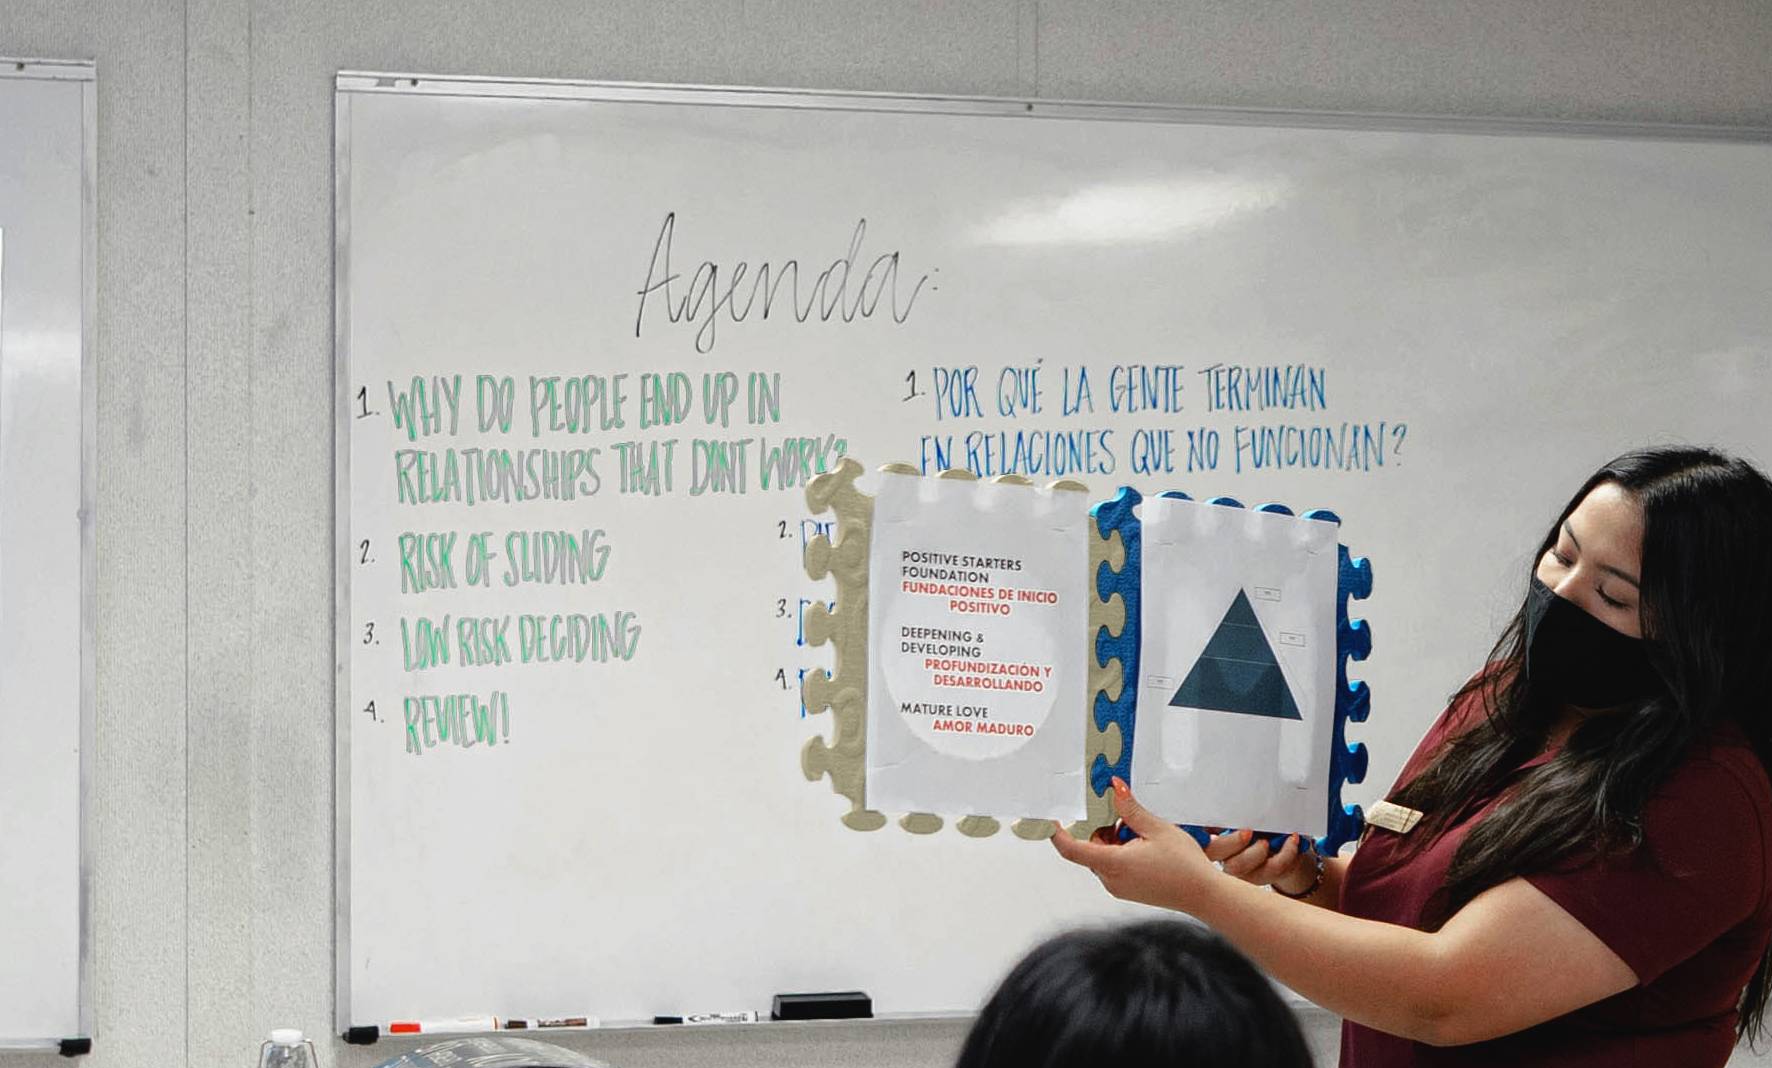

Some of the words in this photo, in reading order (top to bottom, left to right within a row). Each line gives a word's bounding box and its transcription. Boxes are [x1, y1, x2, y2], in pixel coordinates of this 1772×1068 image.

[636, 211, 940, 354] Agenda:
[902, 369, 926, 402] 1.
[933, 364, 984, 421] POR
[997, 358, 1043, 418] QUÉ
[1063, 365, 1094, 417] LA
[1110, 364, 1185, 413] GENTE
[1197, 362, 1327, 413] TERMINAN
[357, 385, 380, 420] 1.
[387, 374, 461, 442] WHY
[476, 374, 514, 434] DO
[529, 374, 628, 438] PEOPLE
[640, 371, 692, 430] END
[703, 371, 739, 428] UP
[748, 372, 780, 424] IN
[921, 433, 953, 477] EN
[965, 429, 1116, 480] RELACIONES
[1130, 428, 1175, 476] QUE
[1187, 426, 1220, 473] NO
[395, 448, 601, 506] RELATIONSHIPS
[611, 439, 678, 497] THAT
[778, 520, 793, 539] 2.
[360, 538, 375, 565] 2.
[398, 530, 458, 594] RISK
[466, 531, 497, 588] OF
[503, 529, 611, 587] SLIDING
[902, 551, 958, 567] POSITIVE
[962, 556, 1022, 571] STARTERS
[902, 566, 989, 584] FOUNDATION
[902, 581, 994, 599] FUNDACIONES
[998, 589, 1014, 600] DE
[1017, 590, 1057, 604] INICIO
[776, 598, 792, 619] 3.
[950, 600, 1010, 615] POSITIVO
[363, 622, 380, 646] 3.
[400, 613, 451, 673] LOW
[456, 614, 512, 667] RISK
[518, 610, 642, 664] DECIDING
[901, 627, 972, 643] DEEPENING
[976, 633, 984, 643] &
[901, 642, 981, 658] DEVELOPING
[925, 658, 1040, 677] PROFUNDIZACIÓN
[1044, 667, 1052, 677] Y
[934, 674, 1043, 692] DESARROLLANDO
[901, 703, 953, 717] MATURE
[956, 706, 988, 718] LOVE
[404, 690, 510, 756] REVIEW!
[933, 720, 972, 733] AMOR
[976, 721, 1034, 736] MADURO
